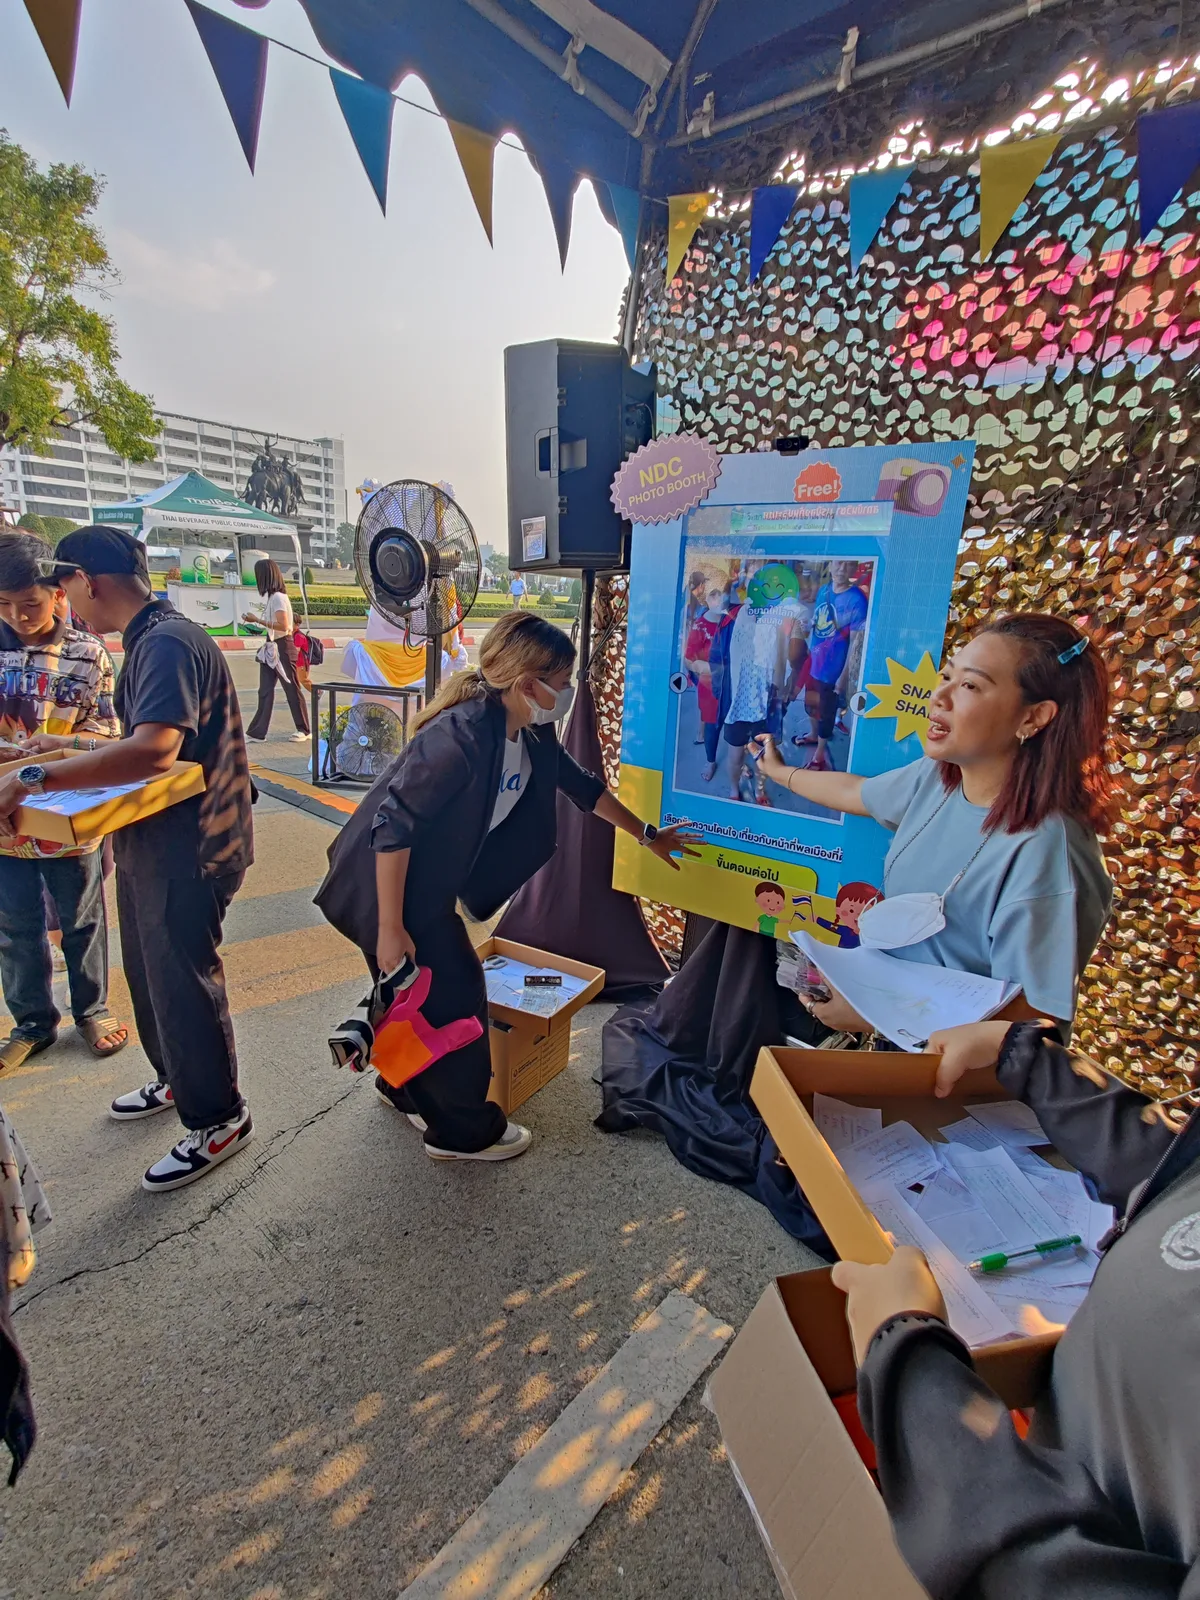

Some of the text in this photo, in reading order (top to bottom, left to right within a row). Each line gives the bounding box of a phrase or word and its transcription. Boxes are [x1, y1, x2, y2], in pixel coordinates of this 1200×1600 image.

[638, 456, 683, 488] NDC
[628, 471, 706, 507] PHOTO BOOTH
[797, 479, 838, 499] Free!
[183, 496, 239, 507] ThaiBev
[161, 514, 178, 522] THAI
[178, 516, 210, 525] BEVERAGE
[210, 519, 232, 527] PUBLIC
[900, 683, 932, 700] SNA
[895, 699, 931, 719] SHA
[716, 853, 780, 882] ขั้นตอนต่อไป
